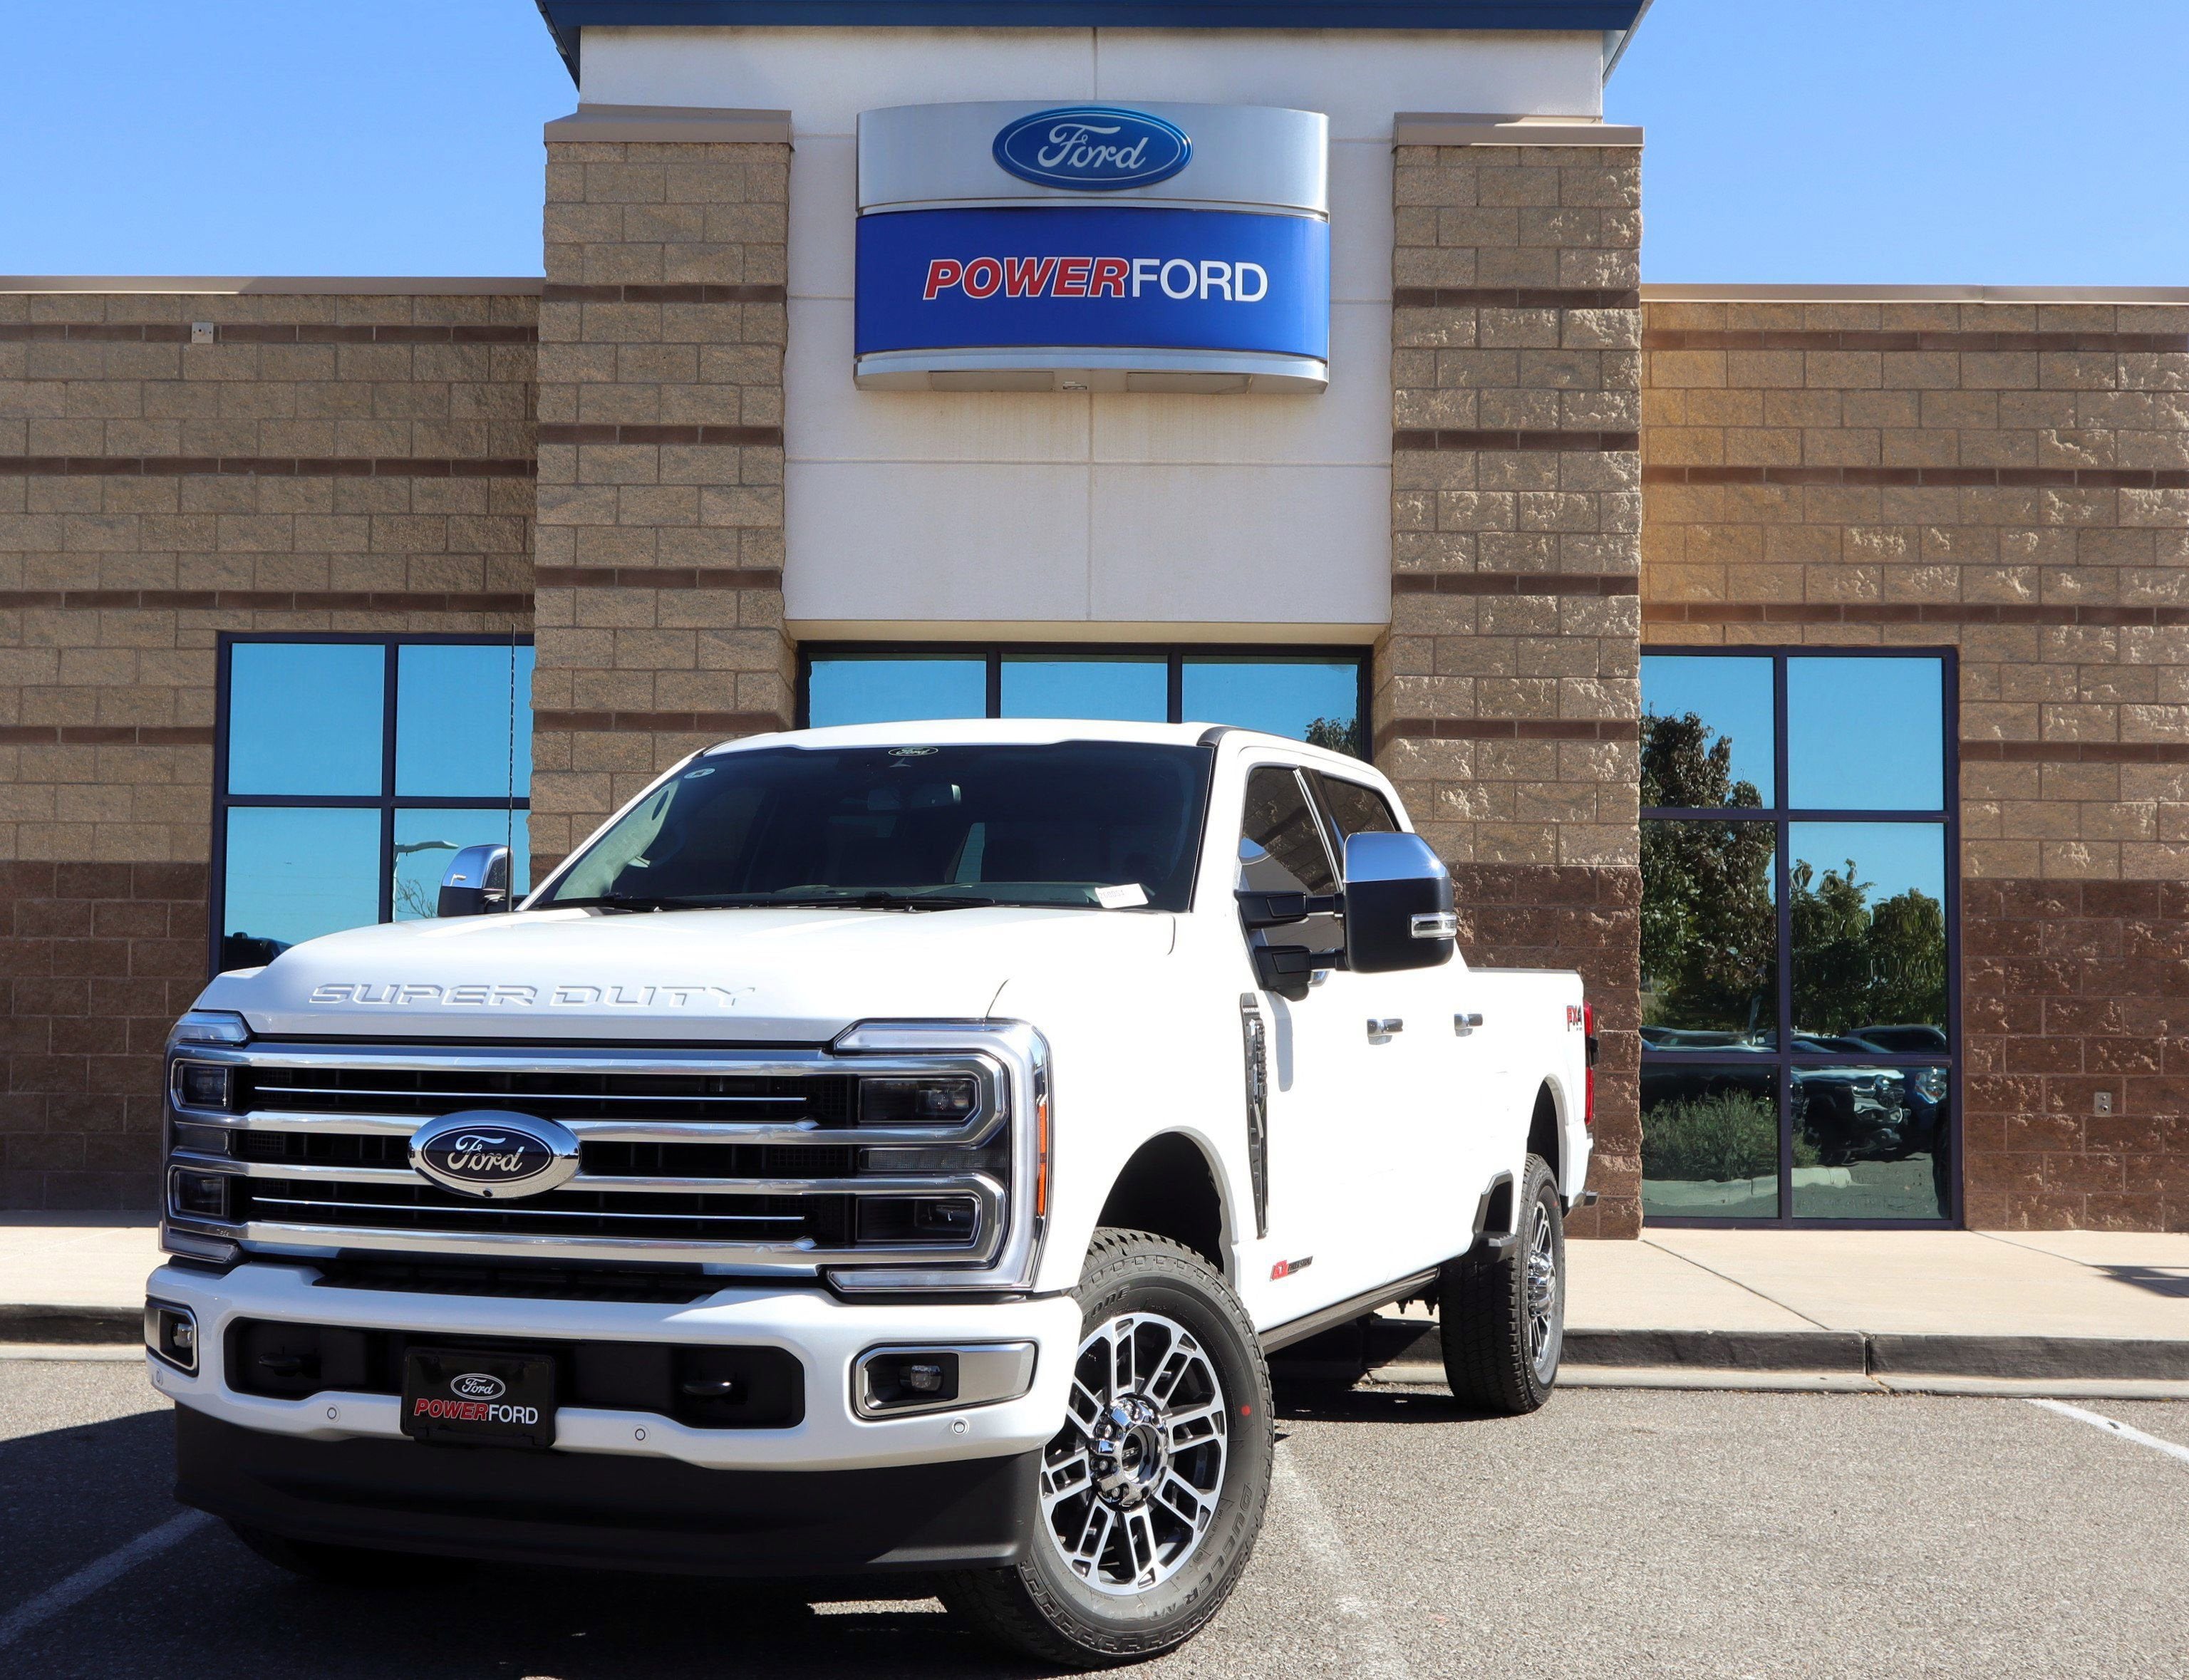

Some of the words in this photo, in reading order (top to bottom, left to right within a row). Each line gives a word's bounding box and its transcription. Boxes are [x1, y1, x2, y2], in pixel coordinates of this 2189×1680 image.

[1037, 123, 1148, 170] Ford
[923, 256, 1268, 302] POWERFORD
[309, 983, 538, 1007] SUPER
[549, 985, 756, 1007] DUTY
[447, 1134, 525, 1172] Ford
[461, 1377, 495, 1395] Ford
[414, 1399, 539, 1424] POWERFORD
